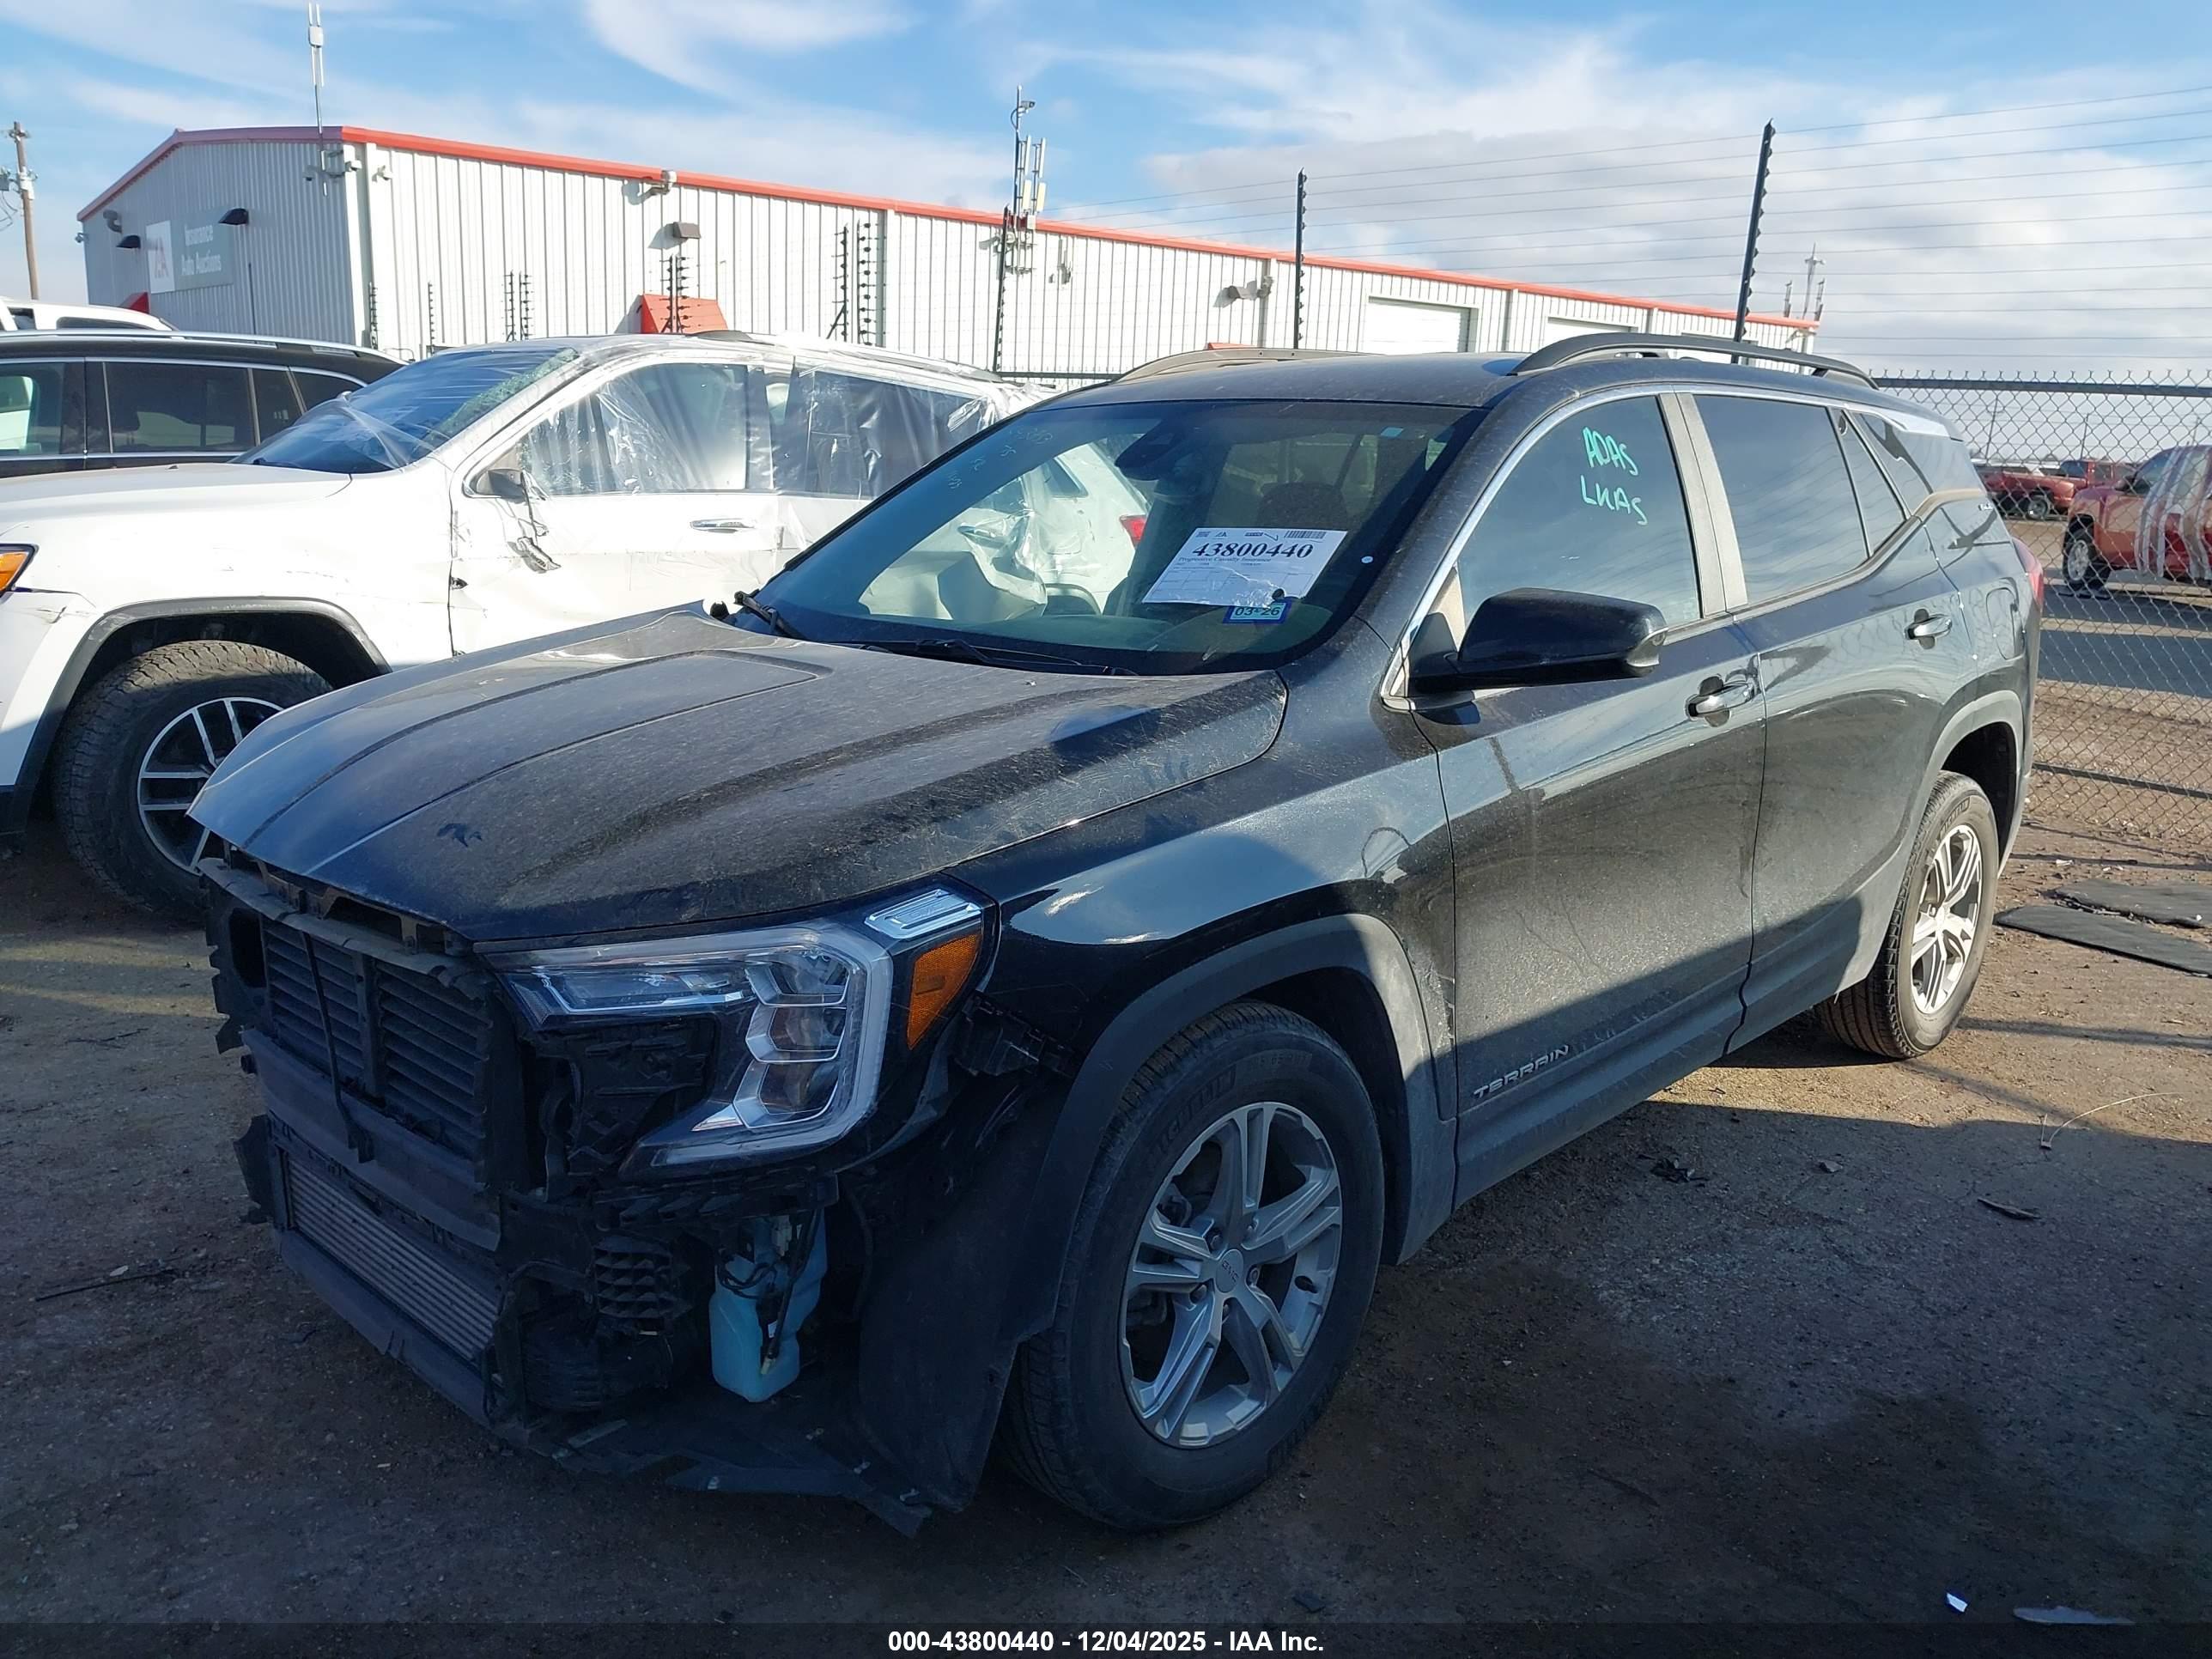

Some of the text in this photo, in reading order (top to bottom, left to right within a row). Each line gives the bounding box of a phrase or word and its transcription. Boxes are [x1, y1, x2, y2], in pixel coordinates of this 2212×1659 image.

[1582, 426, 1638, 476] ADAS
[1192, 543, 1314, 558] 43800440
[1474, 1044, 1569, 1097] TERRAIN
